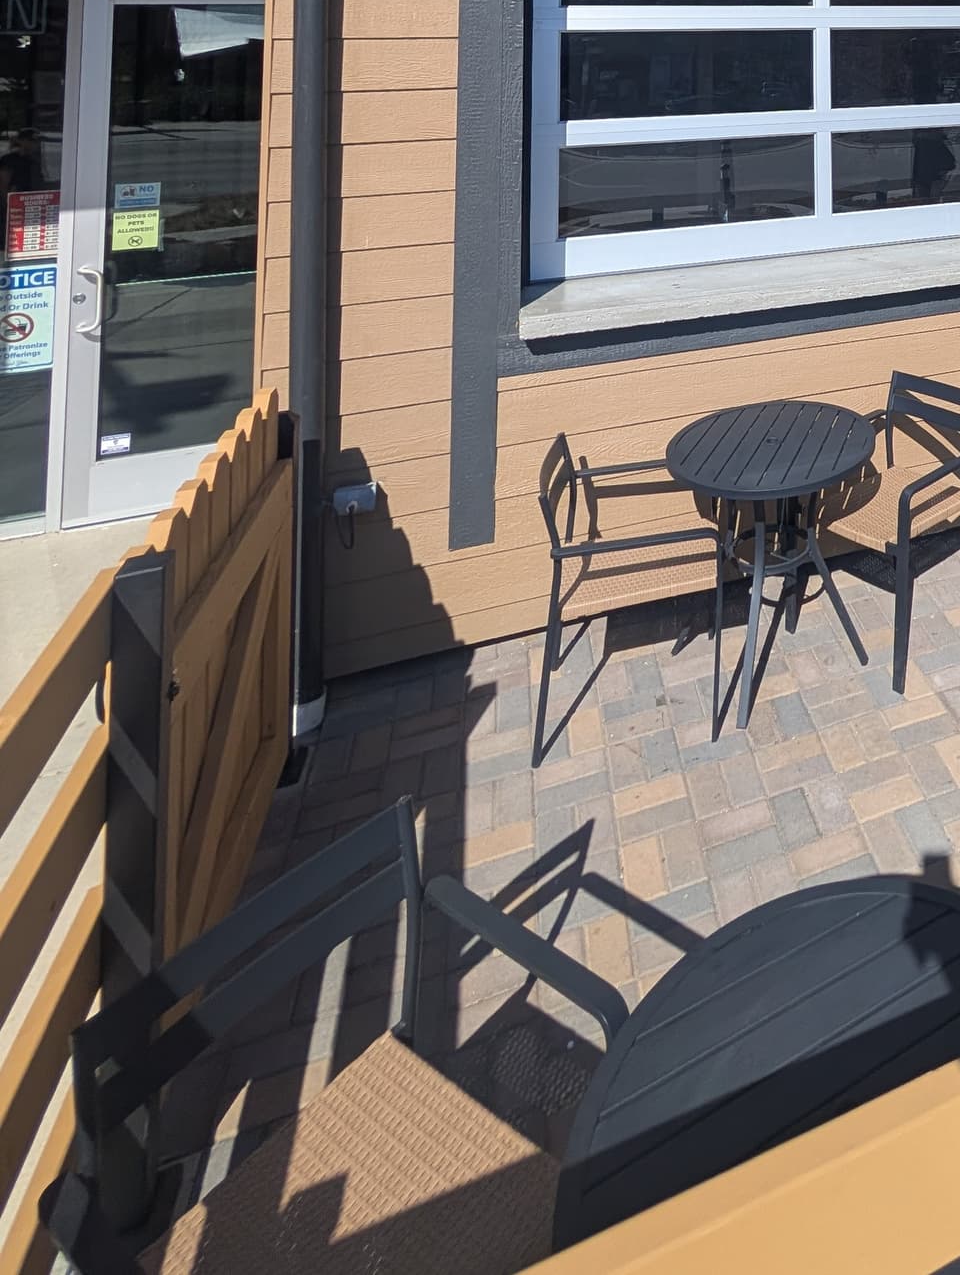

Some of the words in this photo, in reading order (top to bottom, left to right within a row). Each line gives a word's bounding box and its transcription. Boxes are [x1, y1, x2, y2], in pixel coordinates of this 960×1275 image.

[139, 185, 154, 193] NO
[5, 291, 42, 302] Outside
[22, 301, 48, 310] Drink
[8, 342, 48, 352] Patronize
[3, 350, 41, 359] Offerings
